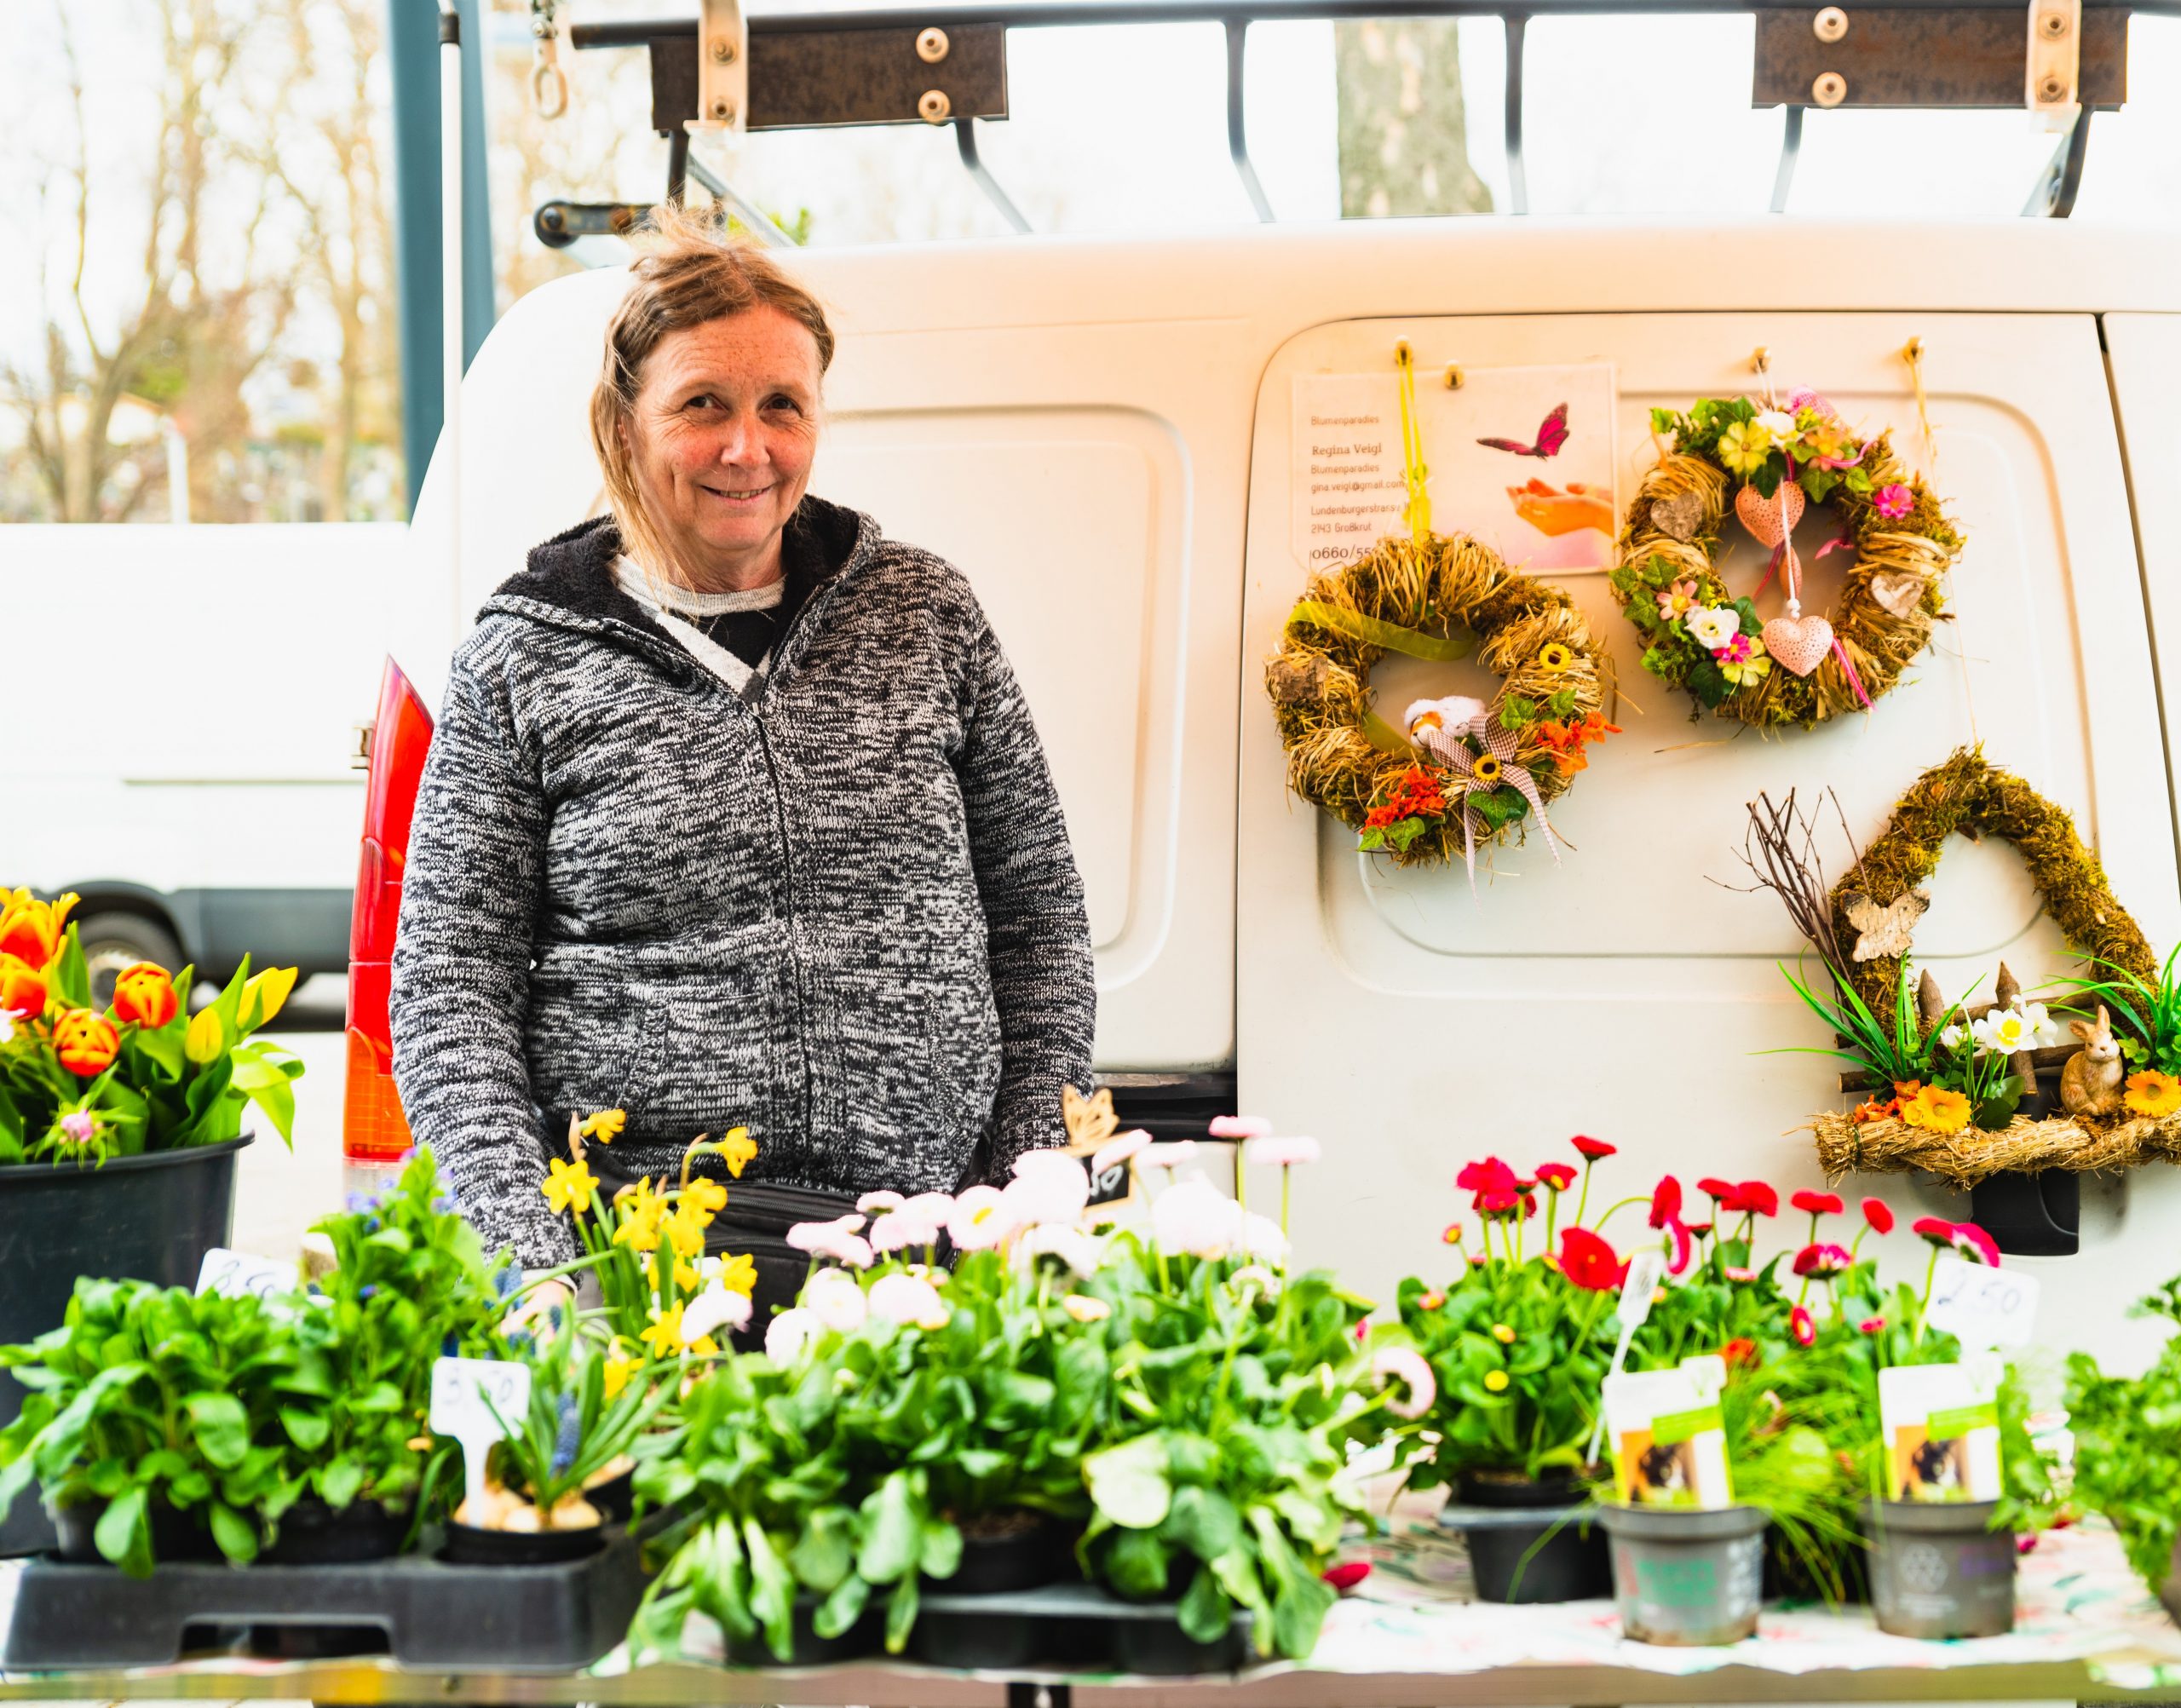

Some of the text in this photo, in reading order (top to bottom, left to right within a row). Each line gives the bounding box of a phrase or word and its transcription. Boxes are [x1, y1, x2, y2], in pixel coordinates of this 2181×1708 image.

[1311, 415, 1379, 426] Blumenparadies
[1312, 442, 1382, 457] Regina Veigl
[1311, 463, 1379, 474] Blumenparadies
[1311, 521, 1372, 534] 2143 Großkrut
